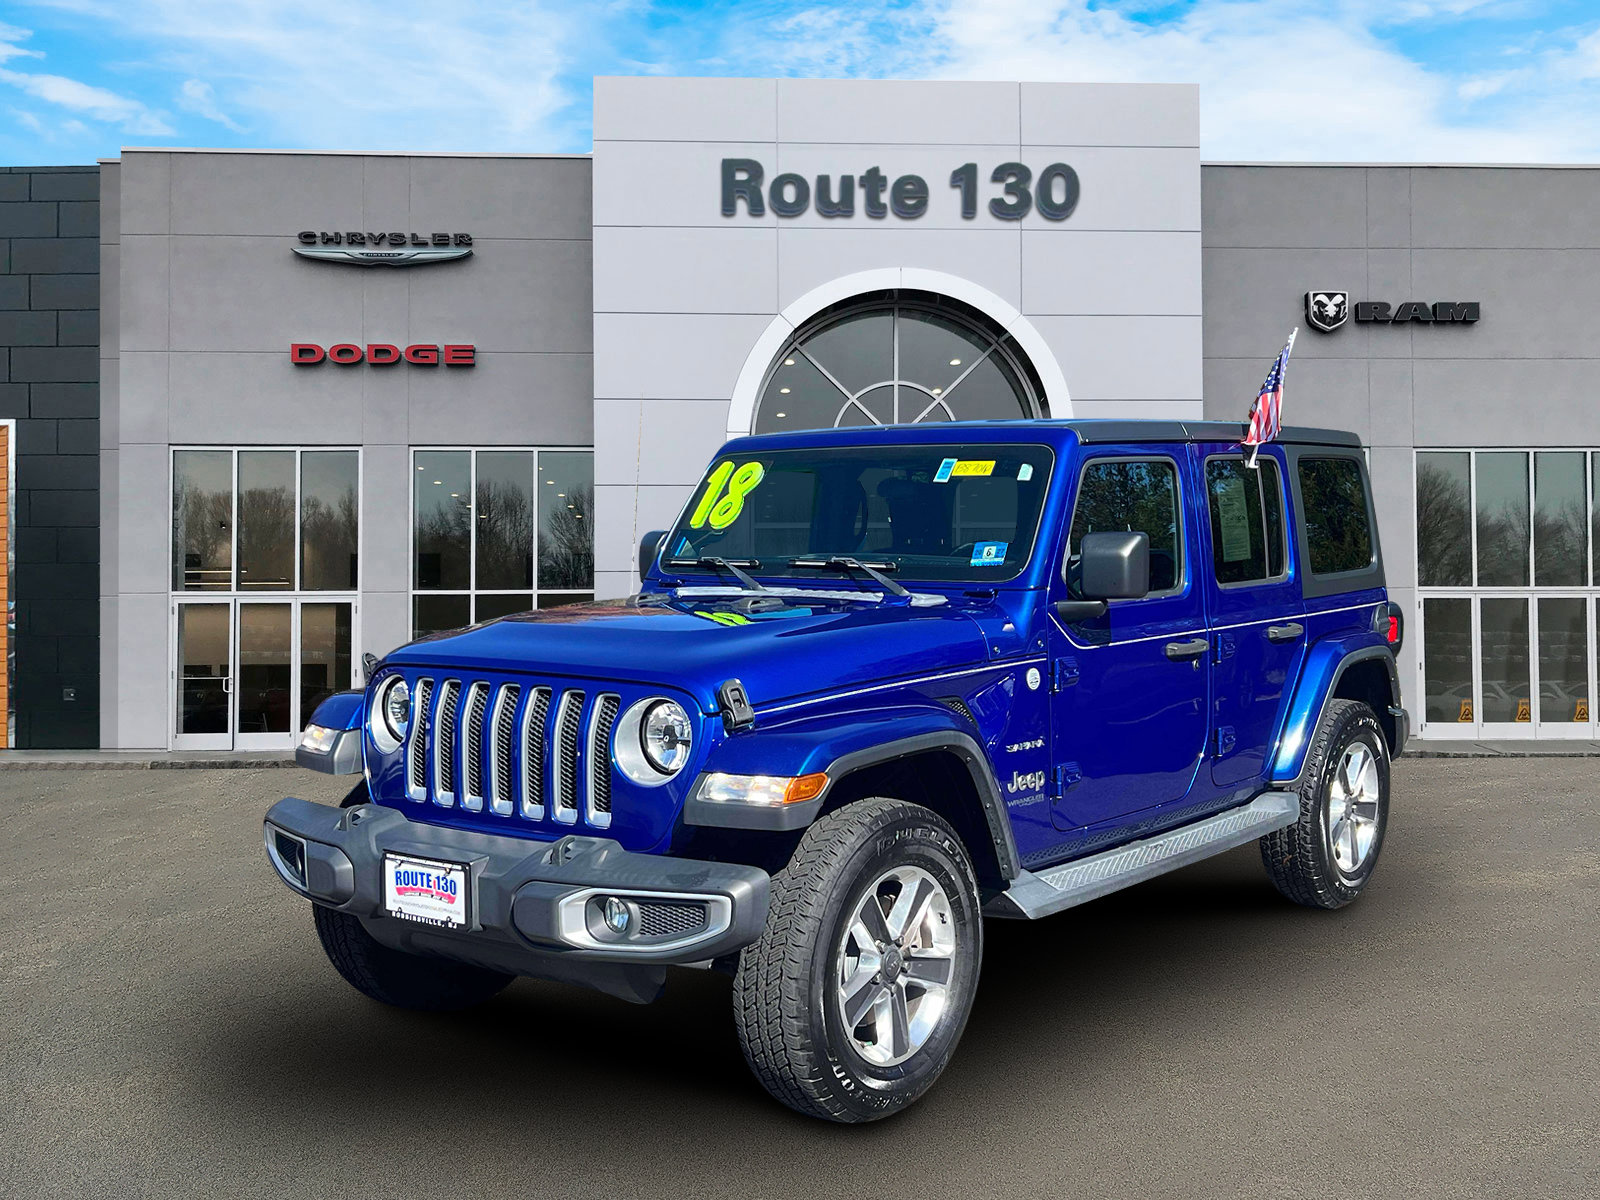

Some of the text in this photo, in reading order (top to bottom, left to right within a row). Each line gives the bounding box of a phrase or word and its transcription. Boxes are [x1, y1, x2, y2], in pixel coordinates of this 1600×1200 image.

[721, 158, 1080, 221] Route 130
[297, 231, 473, 246] CHRYSLER
[1355, 302, 1480, 324] RAM
[291, 343, 476, 366] DODGE
[690, 461, 765, 529] 18
[1007, 770, 1046, 793] Jeep
[395, 870, 457, 896] ROUTE 130
